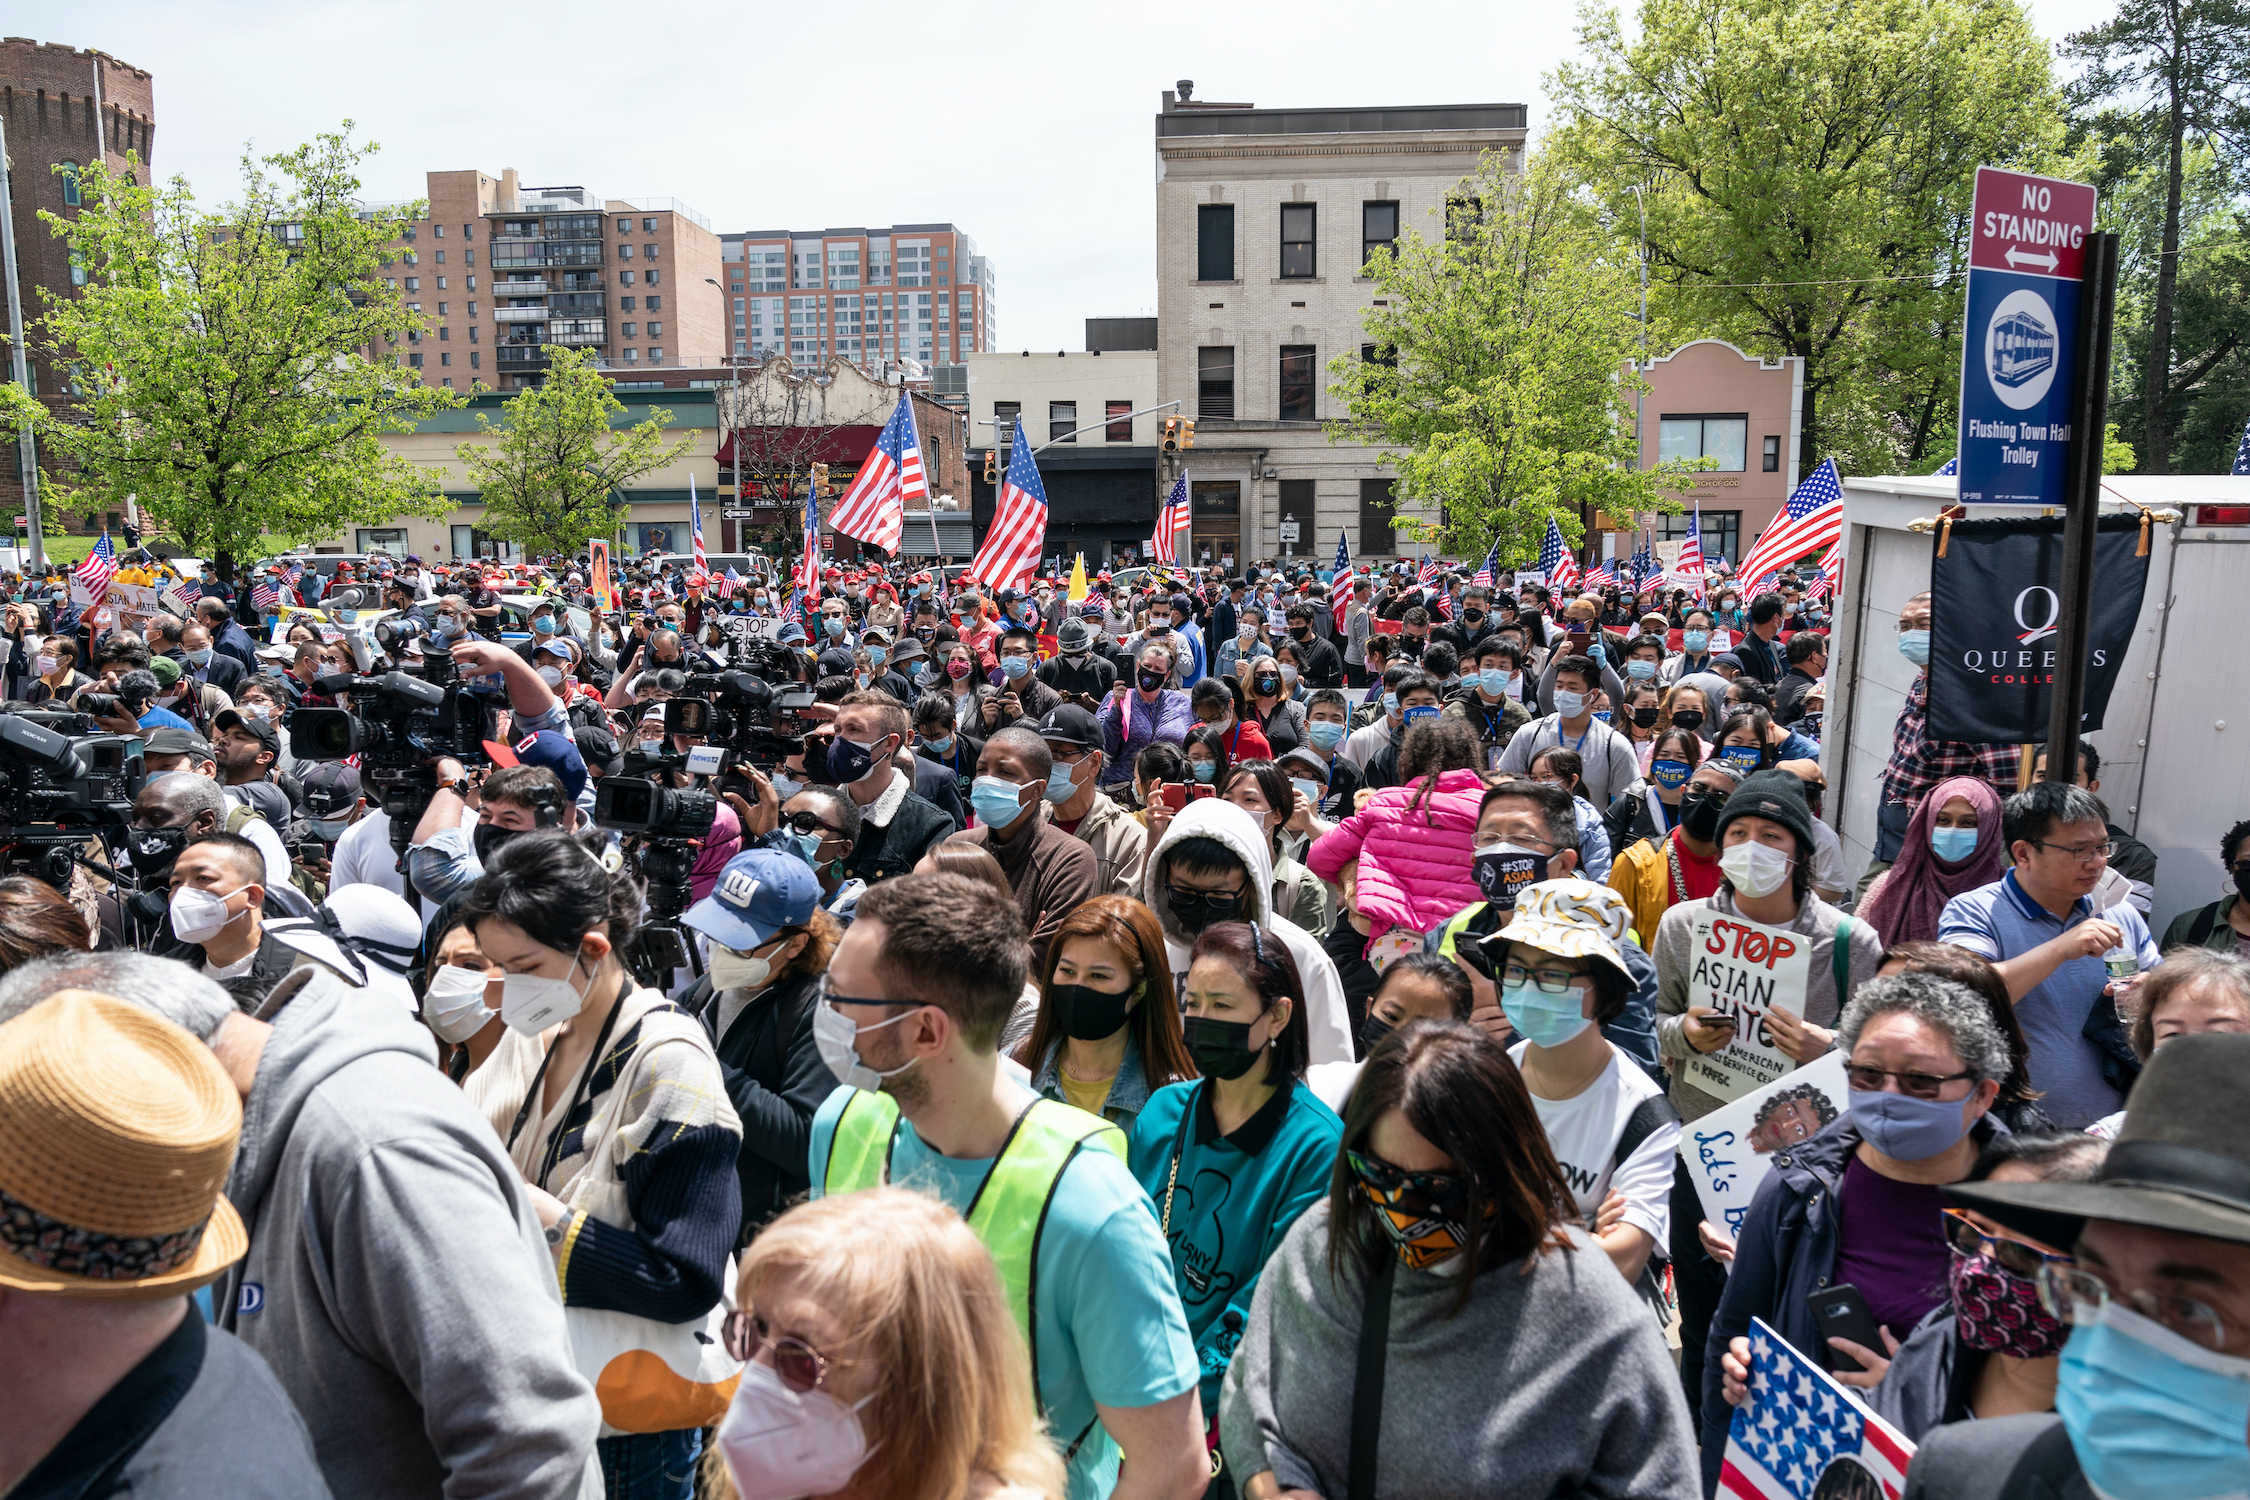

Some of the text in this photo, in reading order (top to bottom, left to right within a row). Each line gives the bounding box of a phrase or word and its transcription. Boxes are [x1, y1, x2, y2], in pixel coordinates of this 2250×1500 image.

[2022, 183, 2051, 213] NO
[1982, 211, 2083, 250] STANDING
[1969, 419, 2071, 443] Flushing Town Hall
[2001, 445, 2039, 468] Trolley
[136, 600, 157, 613] HATE
[733, 617, 769, 633] STOP
[1963, 649, 2106, 674] QUEES
[1991, 674, 2053, 684] COLLE
[1727, 756, 1756, 766] CHEN
[1655, 770, 1685, 781] CHEN
[1501, 859, 1535, 873] #STOP
[1503, 869, 1535, 884] ASIAN
[1698, 919, 1796, 970] #STOP
[1693, 956, 1776, 1008] ASIAN
[1723, 1056, 1756, 1078] SERVICE
[1729, 1044, 1785, 1073] AMERICAN
[1693, 1130, 1737, 1193] Let's
